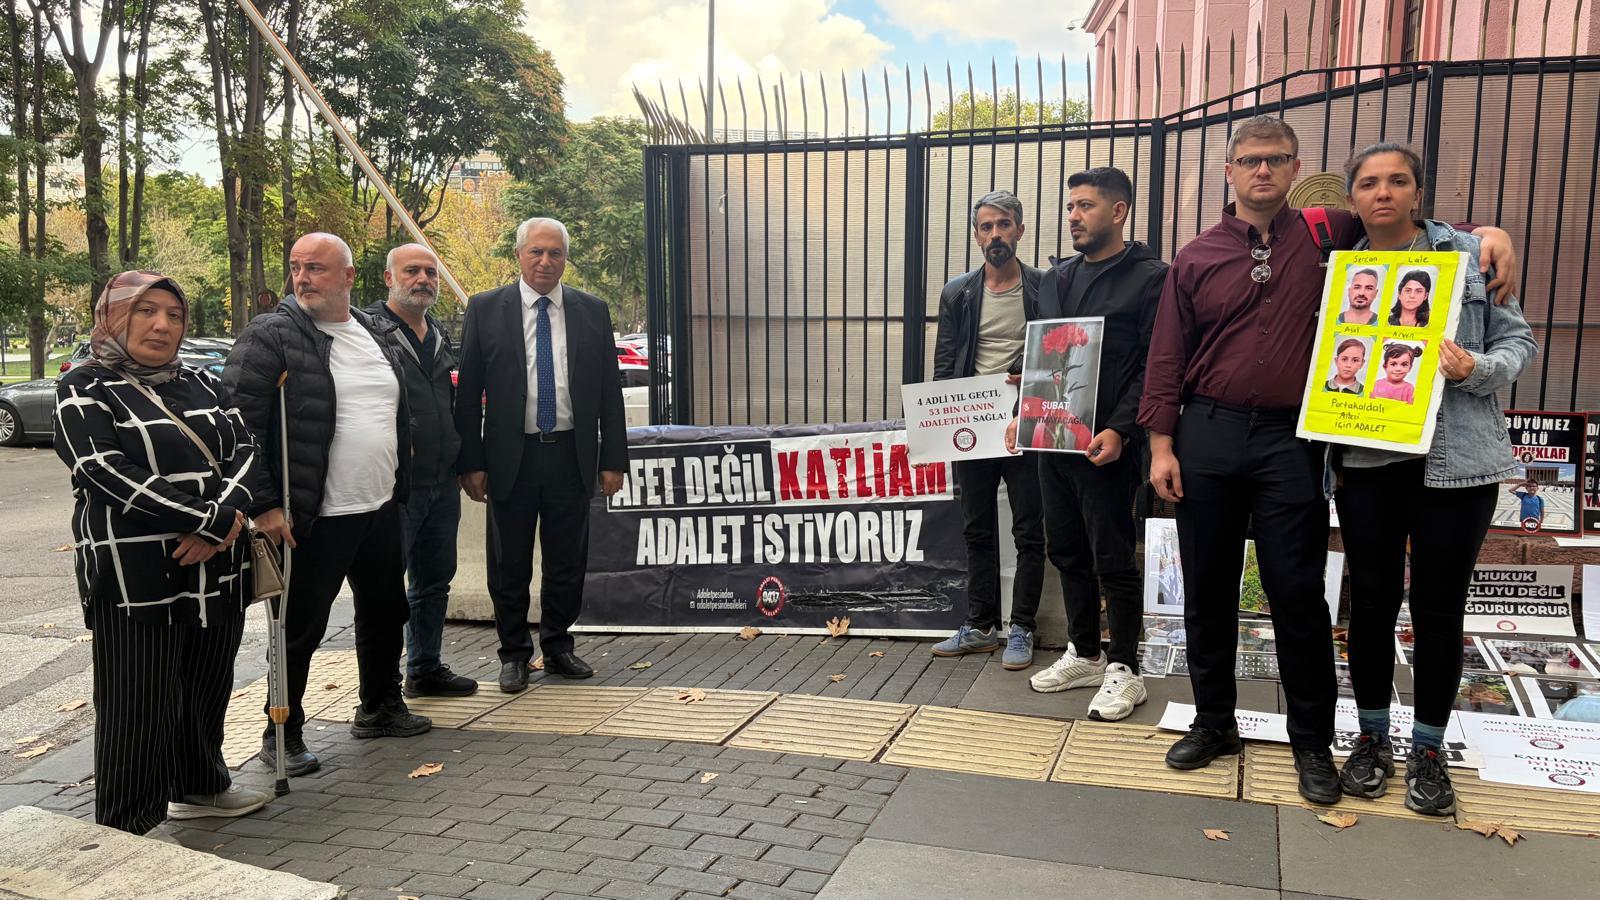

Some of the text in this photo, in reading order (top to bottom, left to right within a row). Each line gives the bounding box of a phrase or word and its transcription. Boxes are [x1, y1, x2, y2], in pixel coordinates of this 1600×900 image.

[1353, 255, 1378, 263] Sercan
[1408, 255, 1429, 263] Lale
[917, 388, 1001, 406] 4 ADLİ YIL GEÇTİ,
[929, 402, 995, 416] 53 BİN CANIN
[918, 412, 1007, 429] ADALETİNİ SAĞLA!
[1354, 423, 1387, 432] ADALET
[1521, 430, 1549, 446] ÖLÜ
[611, 458, 677, 507] AFET
[683, 444, 771, 504] DEĞİL
[636, 509, 924, 565] ADALET İSTİYORUZ
[1478, 571, 1534, 581] HUKUK
[1467, 585, 1562, 598] ÇLUYU DEĞİL
[1465, 601, 1569, 615] ĞDURU KORUR
